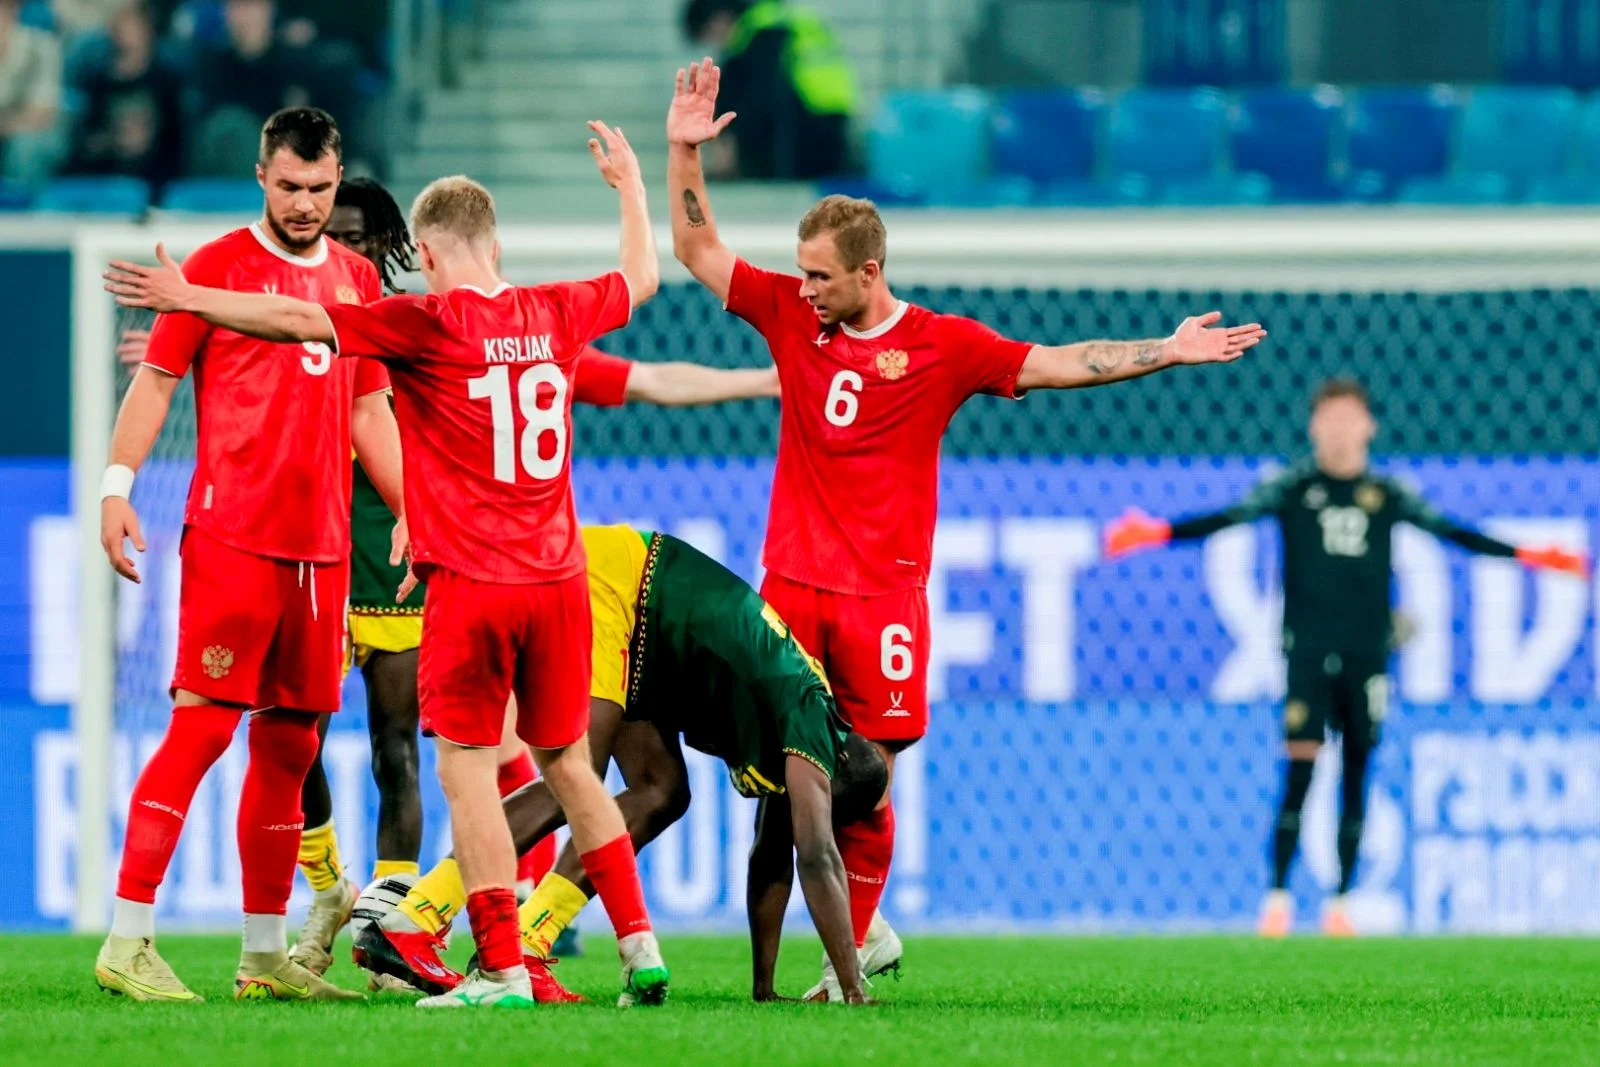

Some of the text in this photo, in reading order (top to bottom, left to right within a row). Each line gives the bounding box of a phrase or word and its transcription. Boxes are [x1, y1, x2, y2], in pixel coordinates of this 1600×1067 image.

[301, 340, 331, 376] 9
[484, 335, 554, 362] KISLIAK
[467, 363, 568, 484] 18
[824, 369, 863, 427] 6
[1317, 505, 1369, 557] 12
[880, 623, 913, 681] 6
